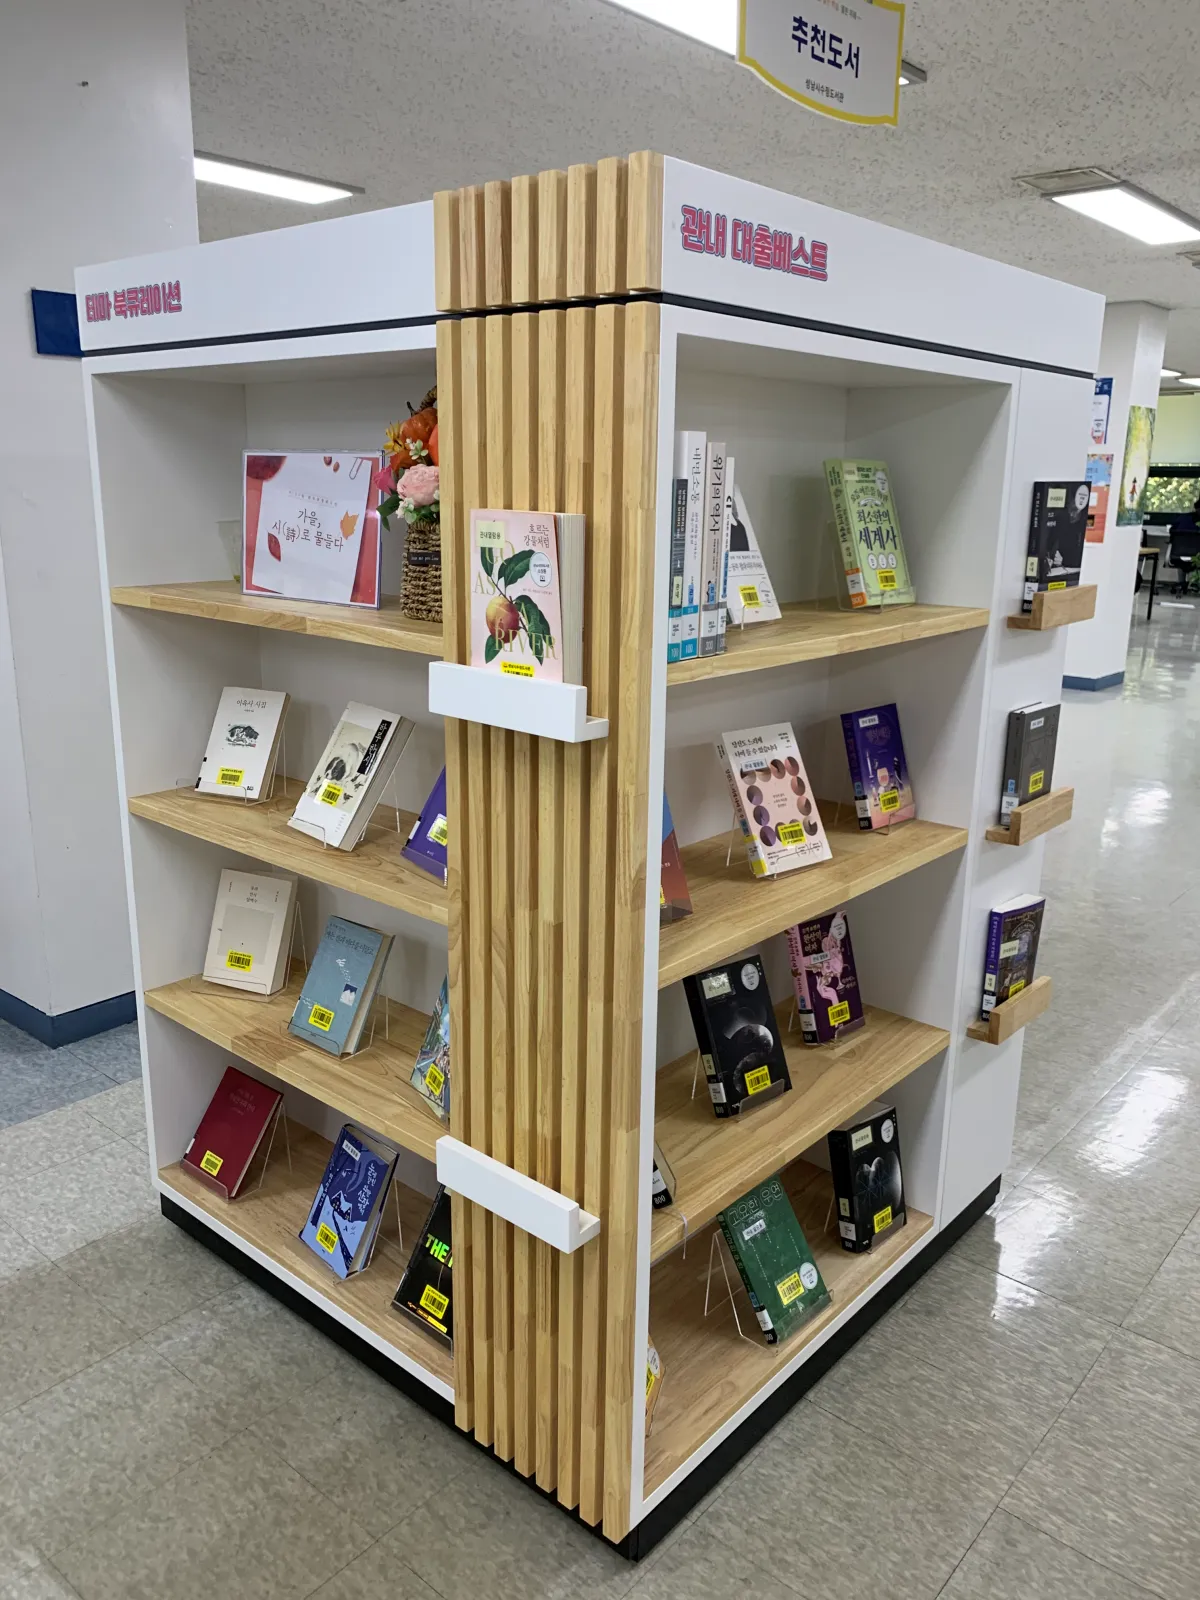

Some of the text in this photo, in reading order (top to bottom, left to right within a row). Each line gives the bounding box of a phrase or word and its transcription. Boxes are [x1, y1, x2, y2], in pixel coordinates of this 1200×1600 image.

[791, 15, 861, 79] 추천도서
[680, 204, 828, 281] 관내 대출베스트
[85, 280, 183, 322] 테마 북큐레이션
[690, 446, 702, 504] 내면소통
[710, 454, 723, 536] 위기의 역사
[297, 508, 321, 529] 가을,
[856, 509, 891, 525] 최소한의
[272, 520, 344, 552] 시(詩)로 물들다
[479, 531, 501, 540] 관내열람용
[523, 535, 550, 548] 강물처럼
[529, 524, 550, 537] 흐르는
[858, 526, 898, 551] 세계사
[494, 626, 559, 660] RIVER
[236, 699, 267, 709] 이육사 시집
[731, 736, 763, 749] 당신도 느리게
[735, 750, 746, 758] 나이
[758, 744, 778, 754] 있습니다
[653, 1194, 666, 1205] 800
[729, 1184, 781, 1226] 고요한 우연
[425, 1233, 450, 1263] THE
